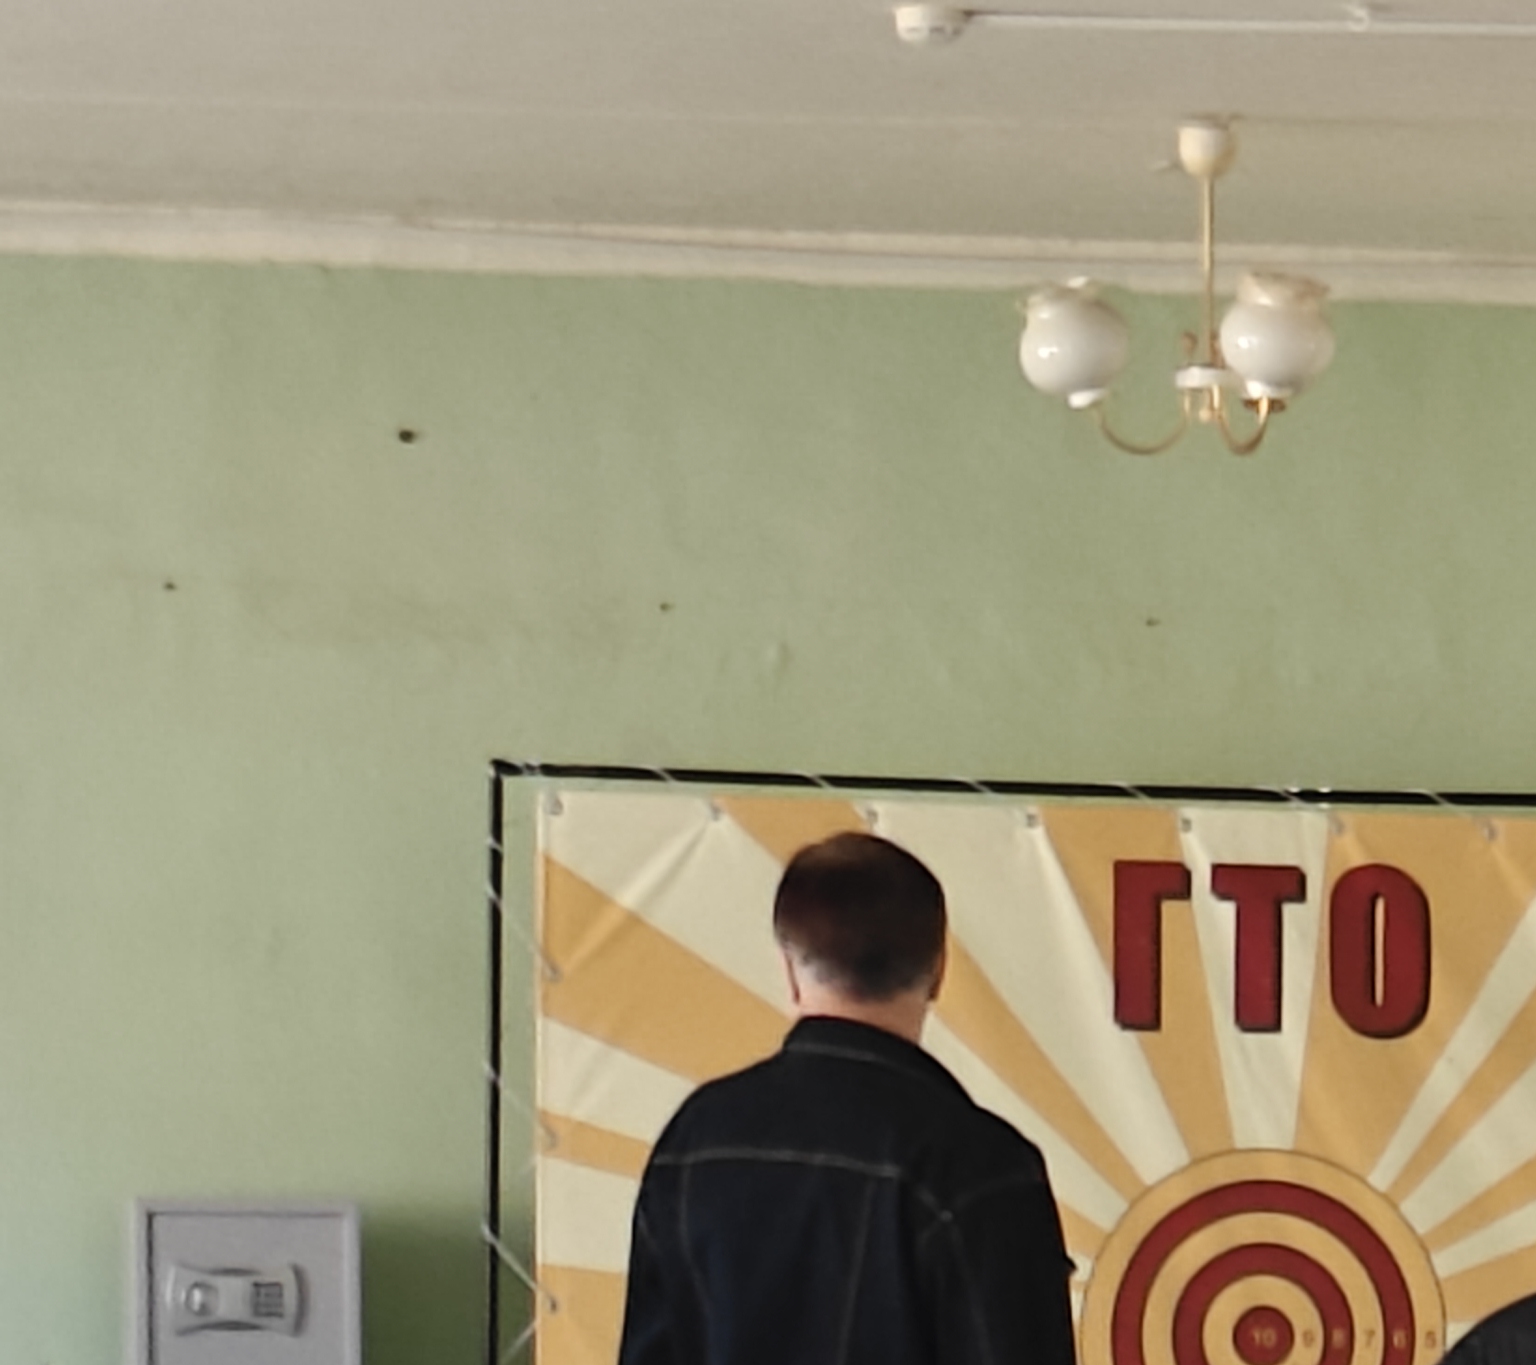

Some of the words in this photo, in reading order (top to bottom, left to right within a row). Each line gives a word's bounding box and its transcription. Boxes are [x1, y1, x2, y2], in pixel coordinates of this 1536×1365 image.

[1112, 860, 1432, 1039] ГТО
[1252, 1326, 1278, 1349] 10
[1302, 1328, 1315, 1349] 9
[1364, 1328, 1376, 1349] 7
[1393, 1327, 1406, 1349] 6
